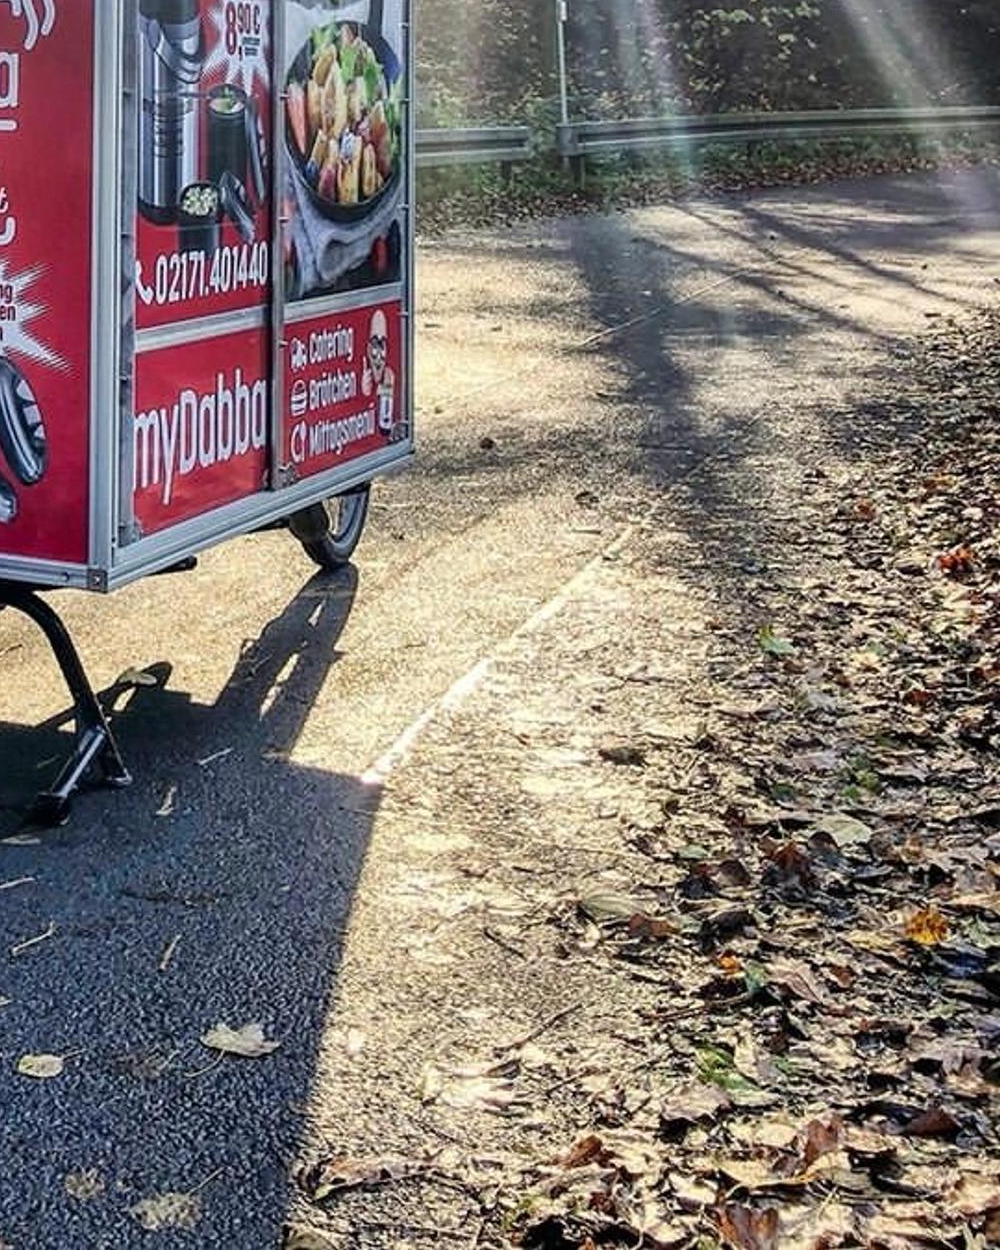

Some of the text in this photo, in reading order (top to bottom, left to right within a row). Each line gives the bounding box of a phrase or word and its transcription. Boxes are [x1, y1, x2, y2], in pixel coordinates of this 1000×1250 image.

[156, 240, 268, 305] 02171.401440
[309, 323, 354, 364] Catering
[133, 368, 266, 506] myDabba
